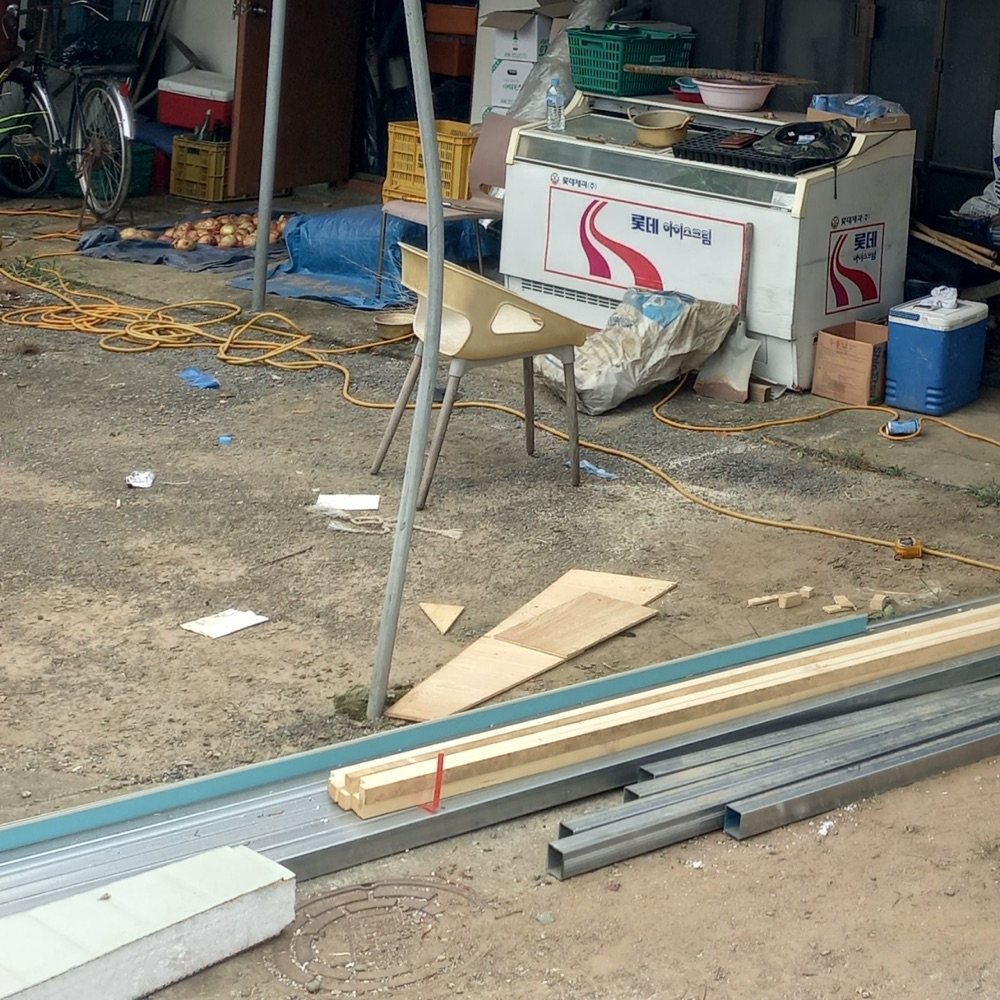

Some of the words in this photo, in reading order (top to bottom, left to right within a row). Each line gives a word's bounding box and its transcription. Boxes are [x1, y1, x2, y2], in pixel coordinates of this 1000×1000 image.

[562, 176, 597, 190] 롯데제과(주)
[631, 213, 659, 234] 롯데
[663, 220, 712, 245] 아이스크림
[854, 231, 878, 250] 롯데
